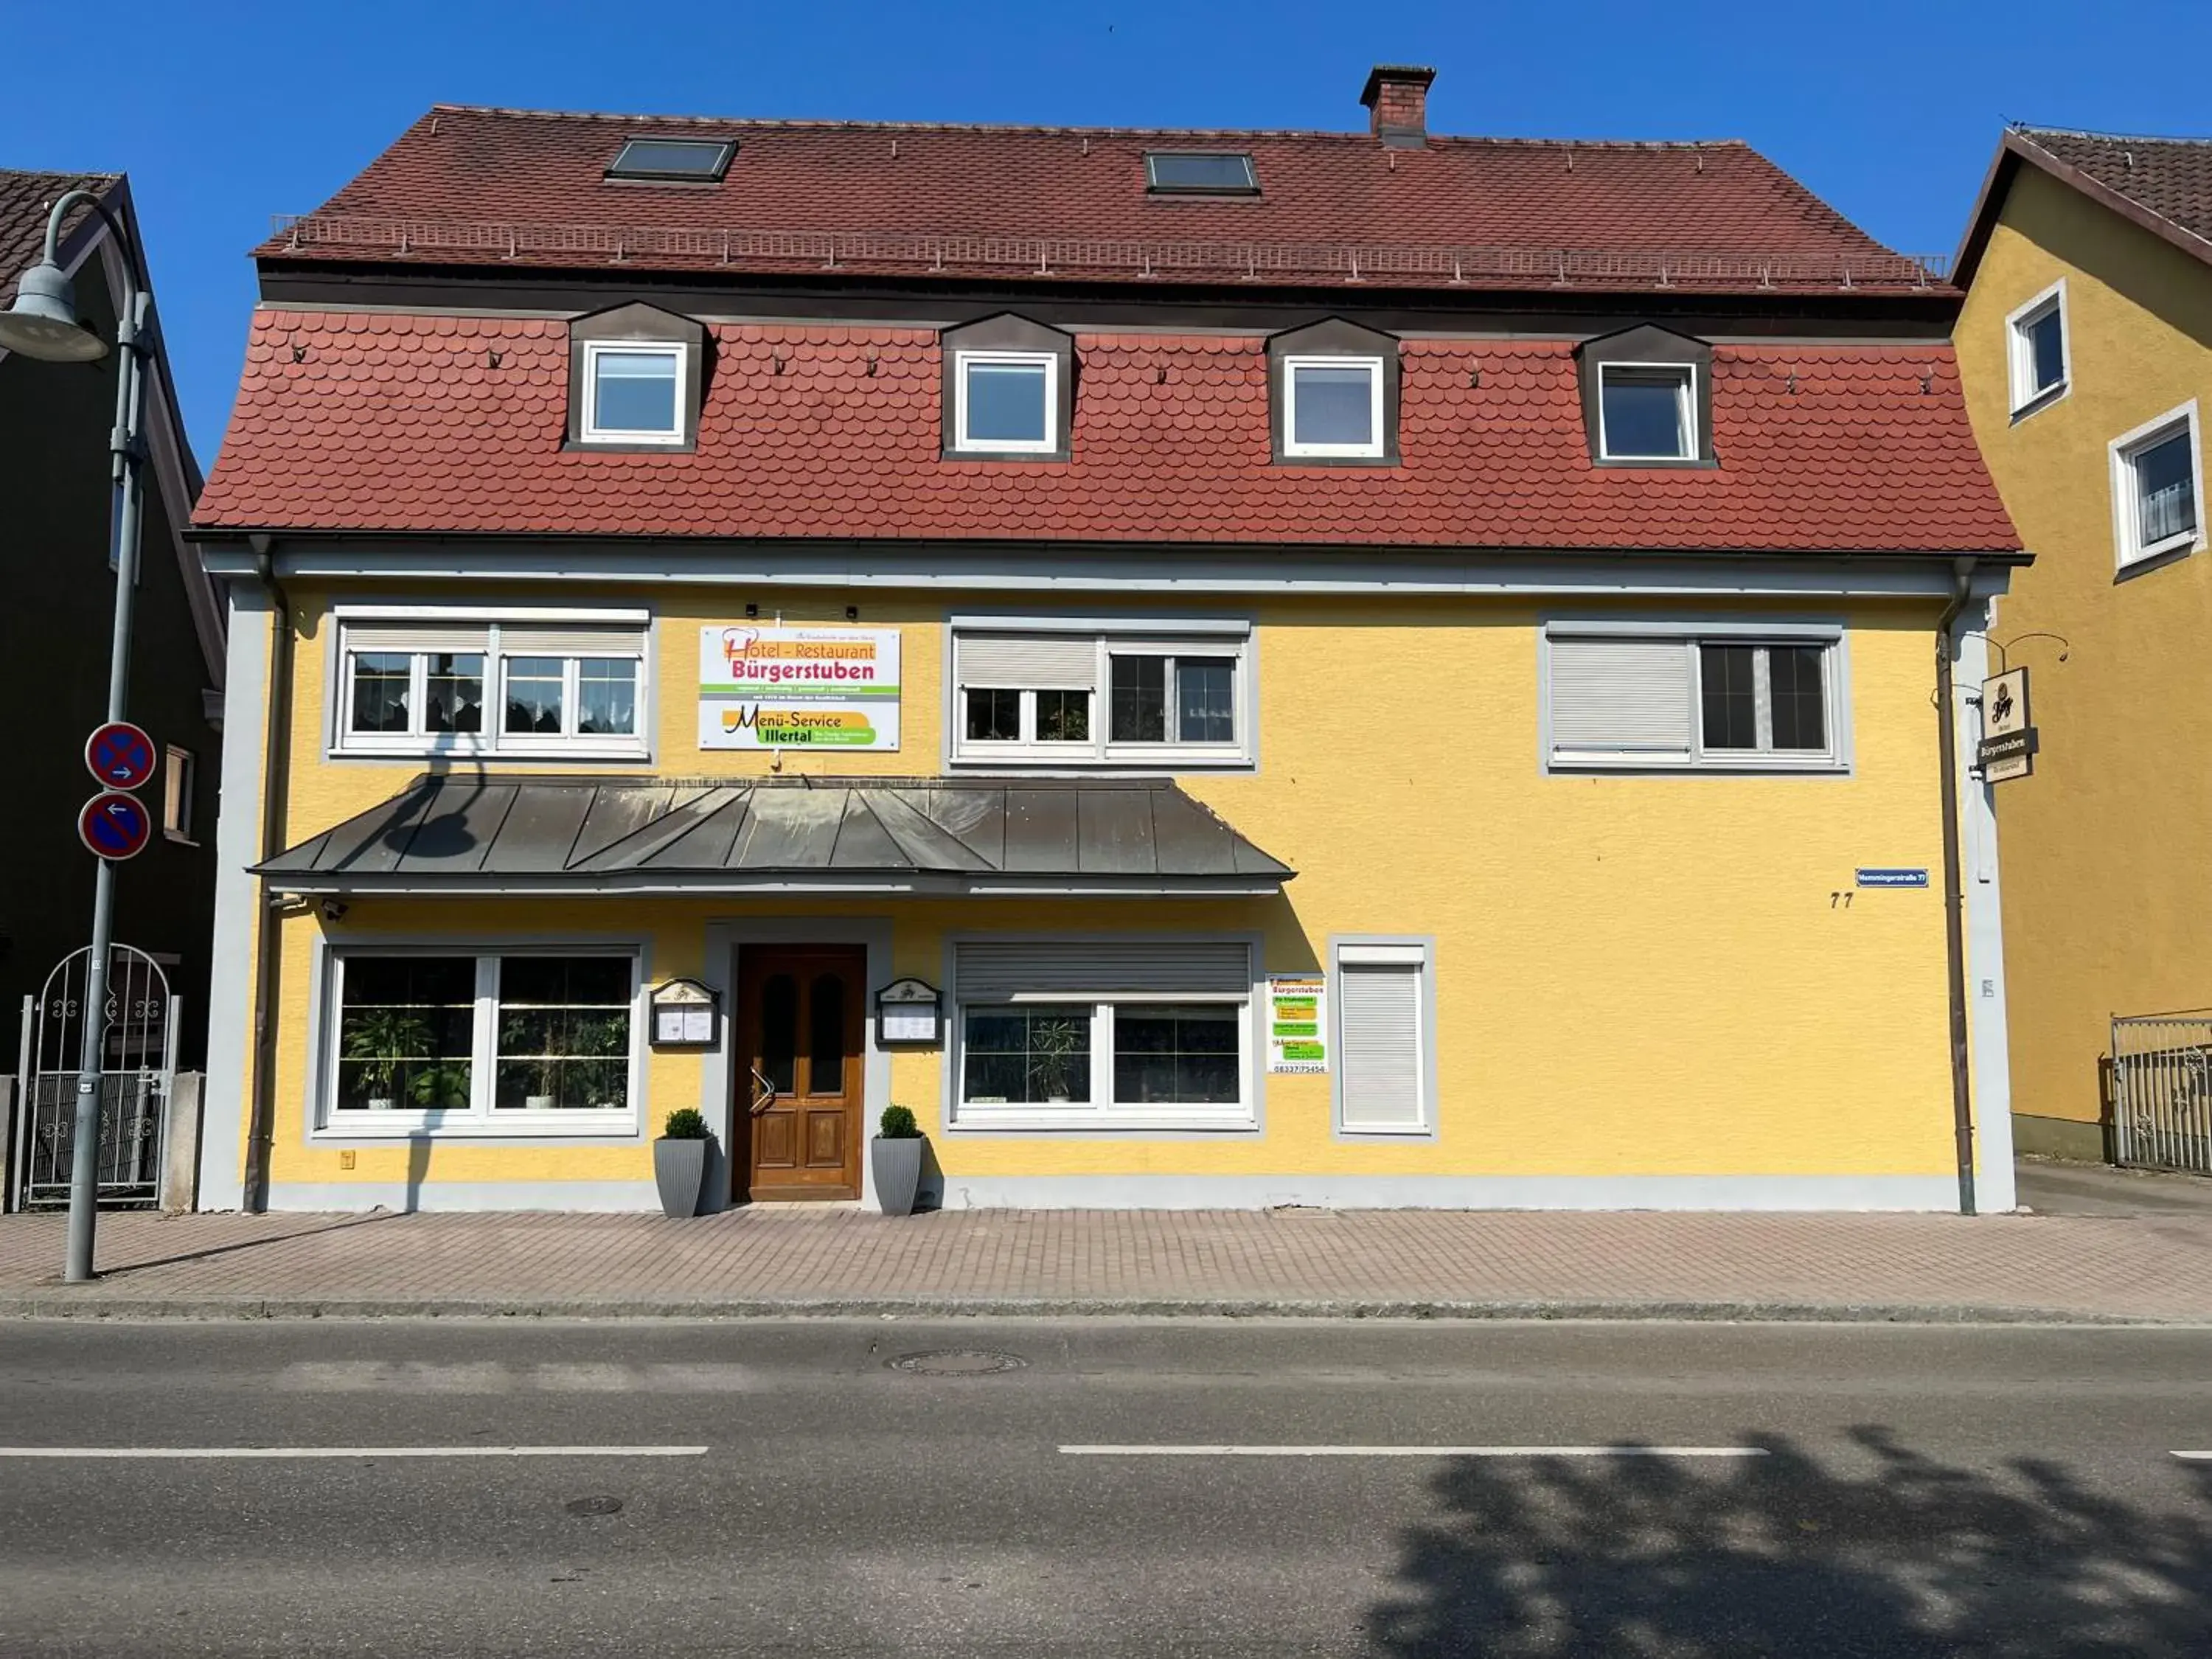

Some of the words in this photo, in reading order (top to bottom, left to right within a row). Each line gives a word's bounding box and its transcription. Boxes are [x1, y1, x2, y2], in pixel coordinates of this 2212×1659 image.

[725, 638, 779, 662] Hotel
[796, 645, 875, 659] Restaurant
[731, 660, 874, 683] Bürgerstuben
[725, 703, 841, 736] Menü-Service
[765, 730, 812, 742] Illertal
[1981, 738, 2025, 757] Bürgerstuben
[1831, 892, 1854, 909] 77
